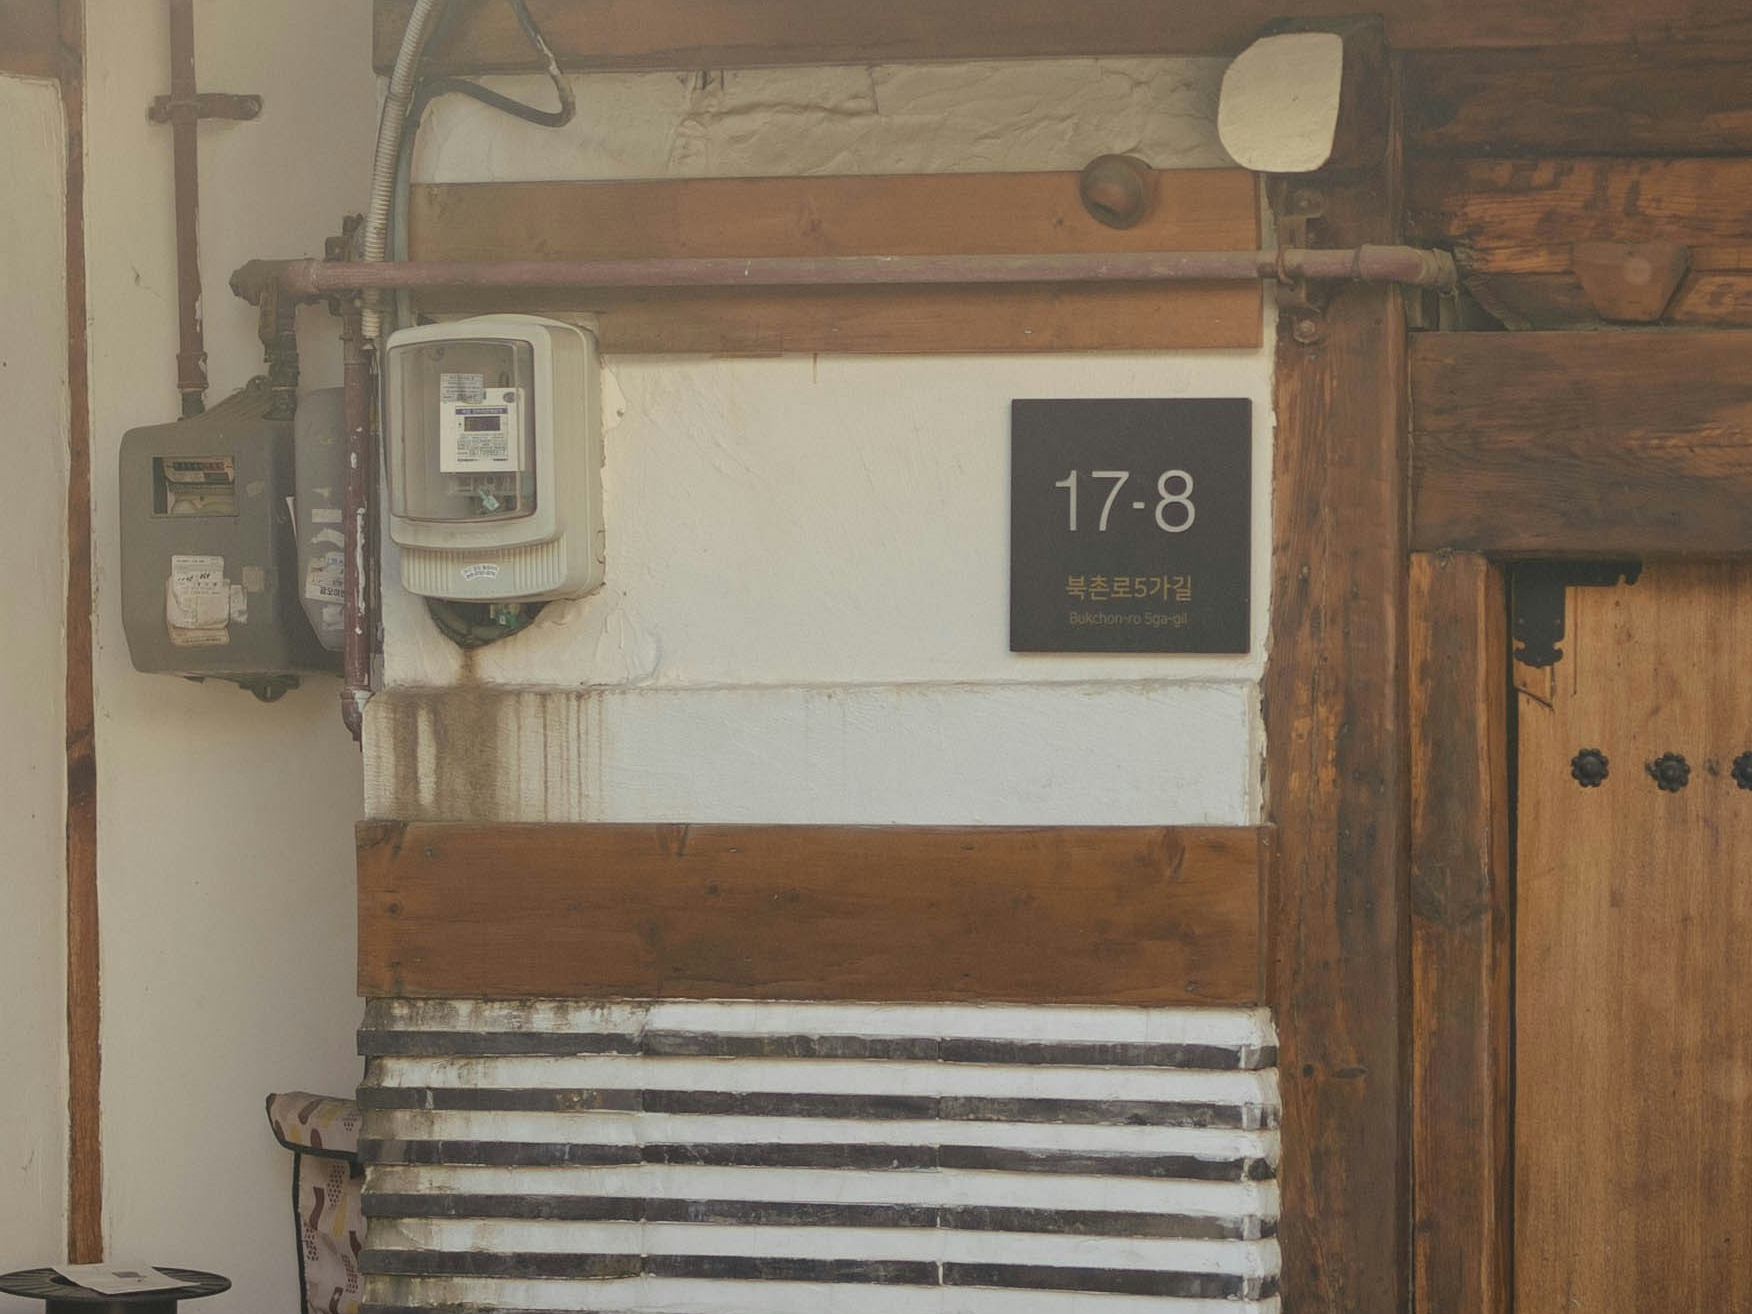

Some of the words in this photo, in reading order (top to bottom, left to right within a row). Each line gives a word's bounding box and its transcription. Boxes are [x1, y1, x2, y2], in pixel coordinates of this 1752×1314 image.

[1055, 469, 1196, 533] 17-8
[1065, 575, 1192, 602] 북촌로5가길
[1069, 611, 1141, 626] Bukchon-ro
[1144, 611, 1188, 628] 5ga-gil
